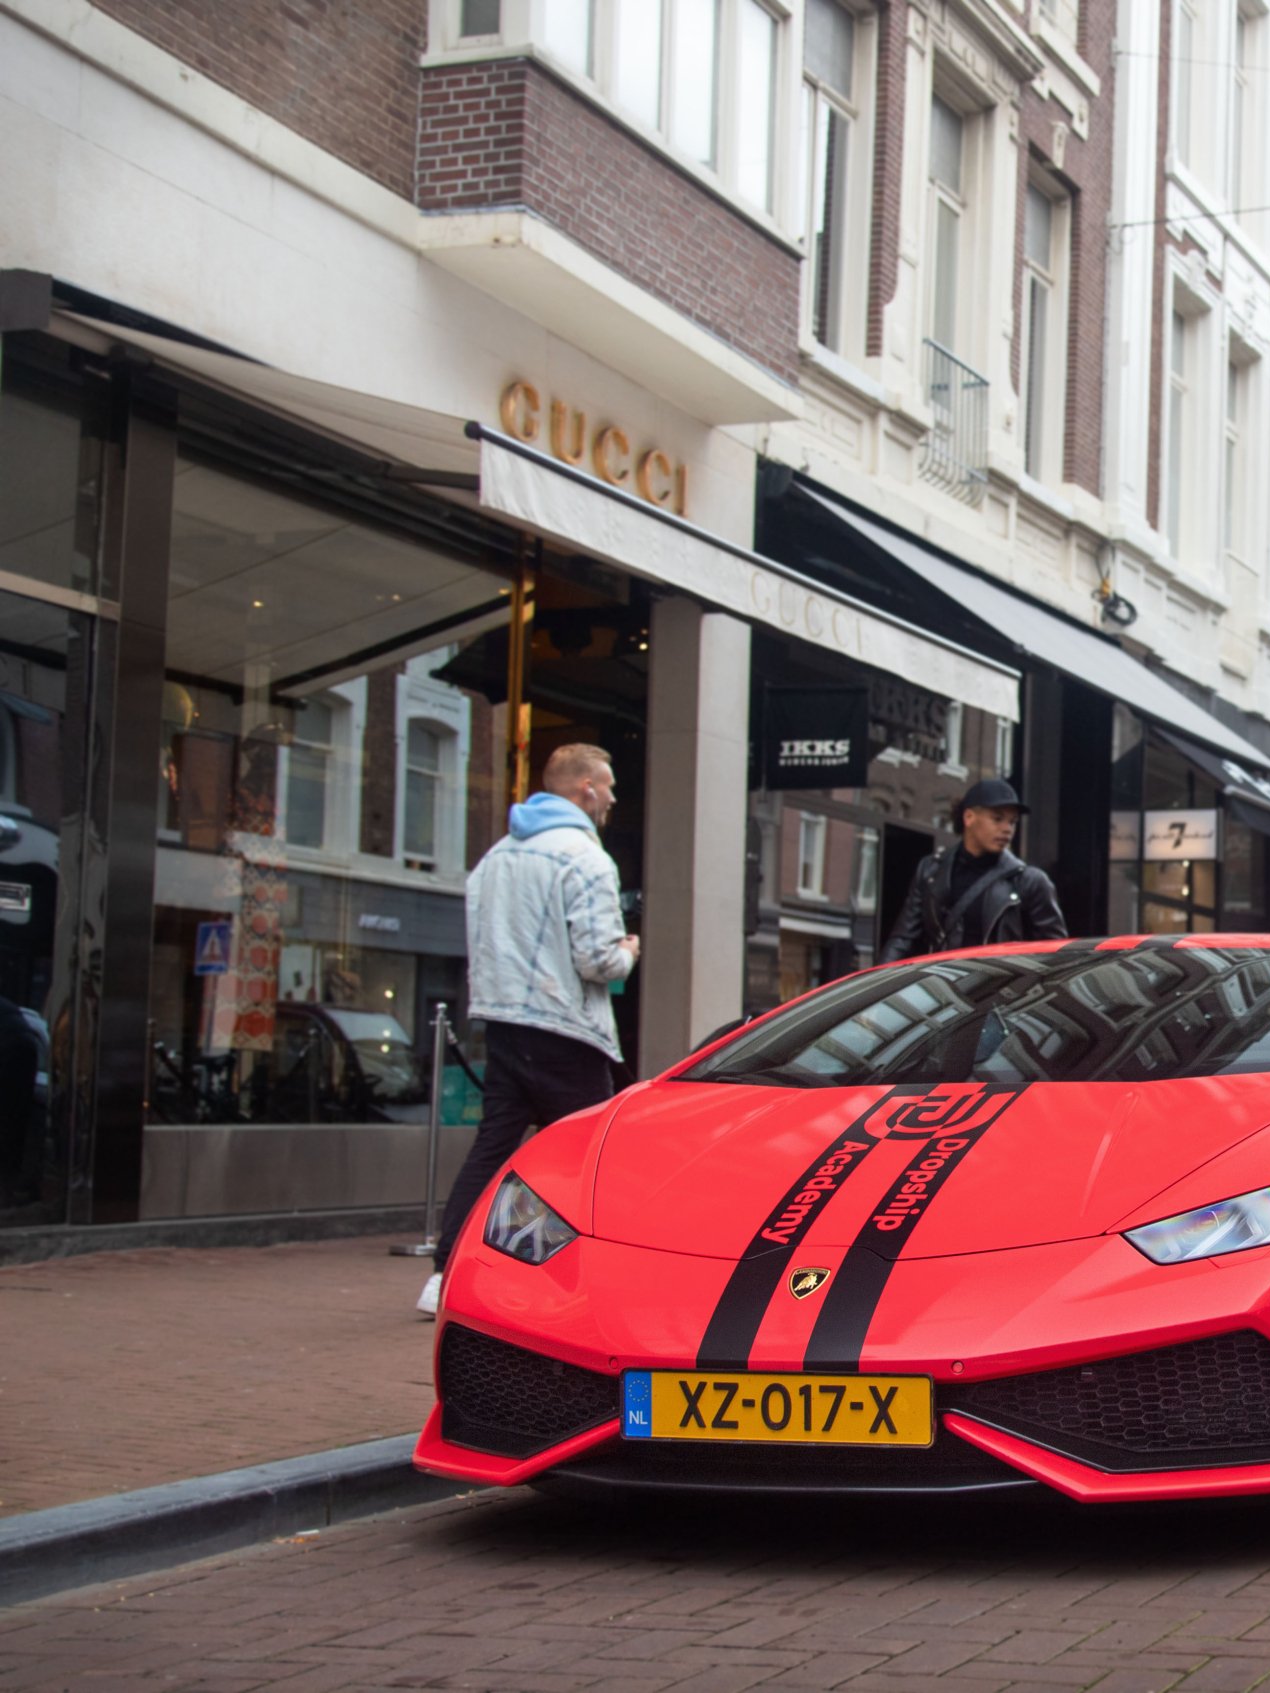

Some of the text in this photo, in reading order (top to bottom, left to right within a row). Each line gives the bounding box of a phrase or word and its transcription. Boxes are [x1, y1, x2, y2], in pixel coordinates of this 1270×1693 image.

[500, 381, 687, 517] GUCCI
[750, 571, 863, 655] GUCCI
[780, 739, 850, 757] IKKS
[761, 1141, 870, 1245] Academy
[873, 1138, 970, 1231] Dropship
[628, 1410, 648, 1425] NL
[679, 1380, 899, 1434] XZ-017-X
